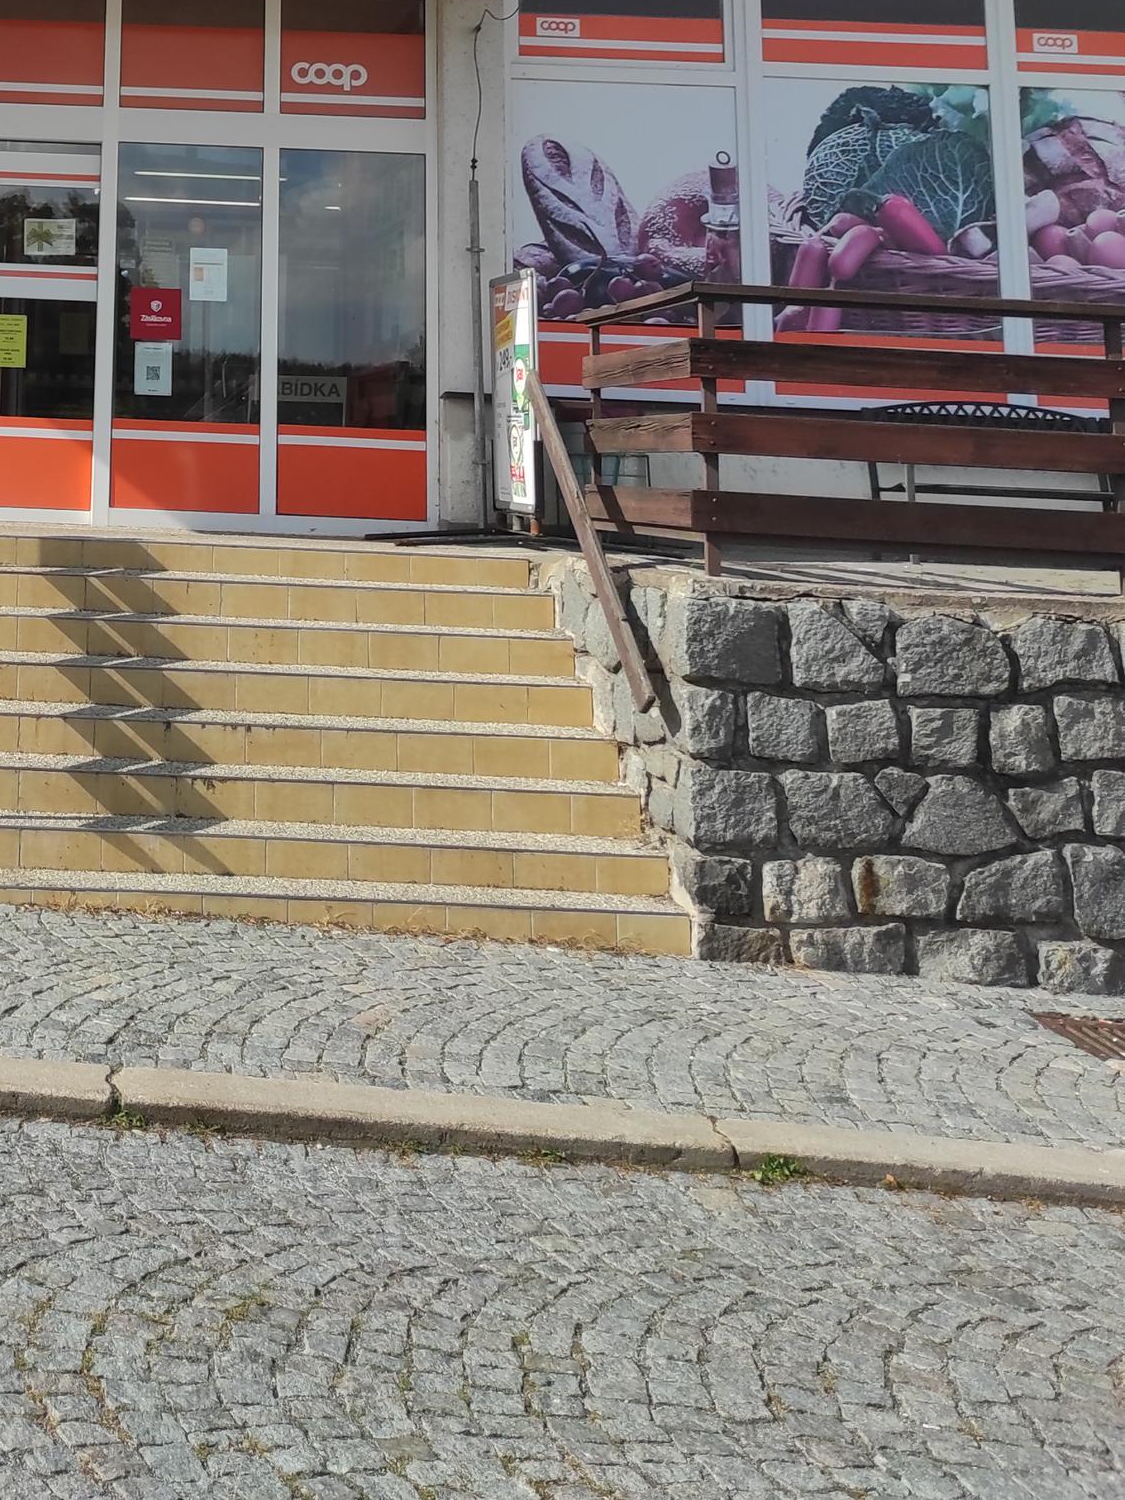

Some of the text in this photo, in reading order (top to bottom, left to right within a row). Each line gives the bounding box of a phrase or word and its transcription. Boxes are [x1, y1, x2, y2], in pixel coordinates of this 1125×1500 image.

[540, 20, 575, 34] coop
[1037, 36, 1073, 50] coop
[291, 62, 367, 91] coop
[278, 379, 341, 397] BÍDKA
